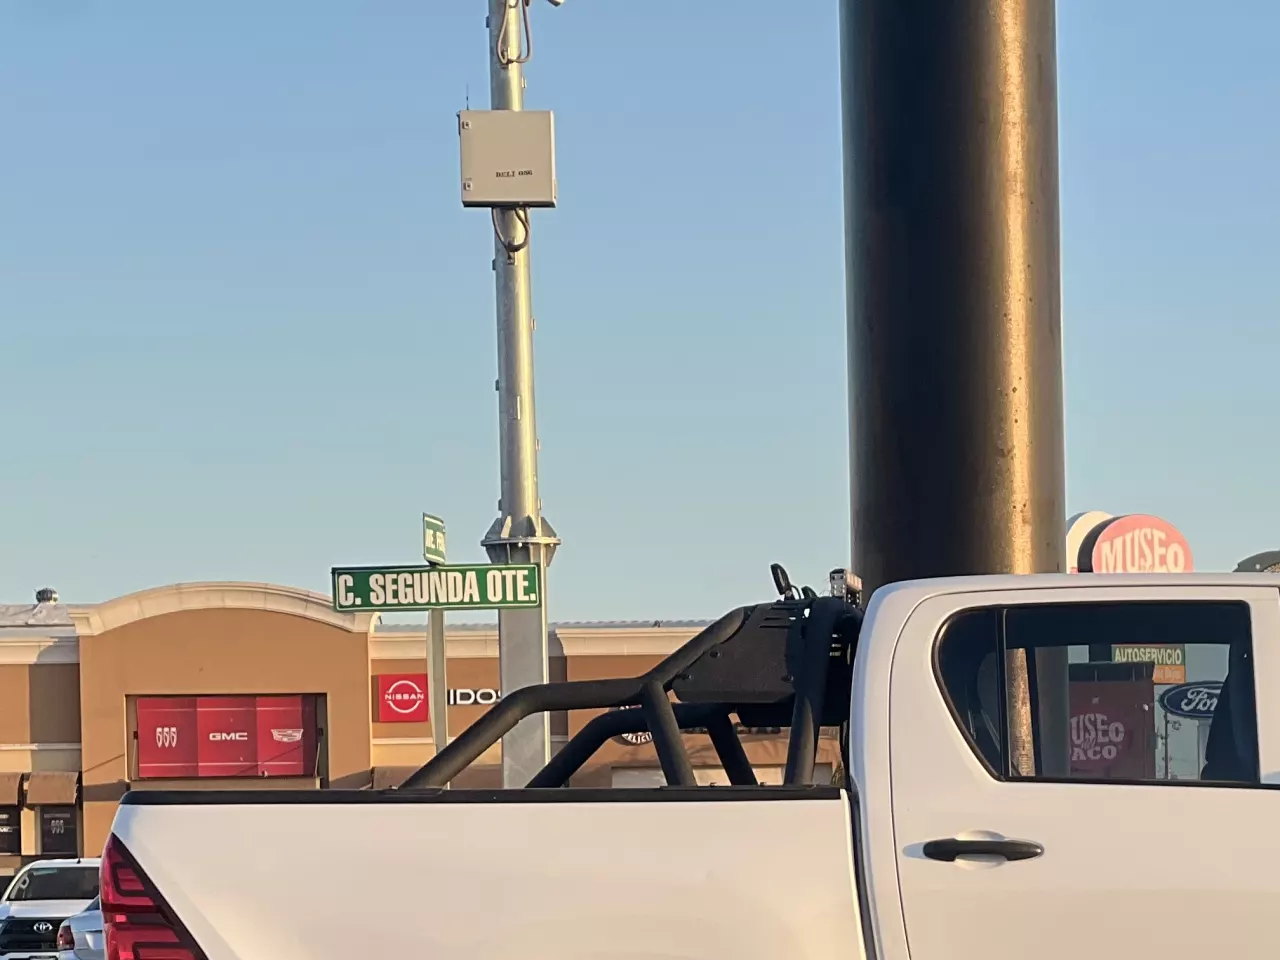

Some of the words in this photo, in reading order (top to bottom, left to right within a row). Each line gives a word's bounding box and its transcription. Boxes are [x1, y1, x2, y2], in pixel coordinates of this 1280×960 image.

[1101, 527, 1185, 573] MUSEO
[338, 574, 362, 606] C.
[369, 571, 480, 605] SEGUNDA
[486, 570, 537, 603] OTE.
[1114, 647, 1182, 665] AUTOSERVICIO
[384, 693, 424, 701] NISSAN
[449, 688, 500, 706] IDO
[1181, 688, 1221, 712] For
[209, 731, 248, 741] GMC
[1070, 713, 1125, 745] USEO
[1070, 745, 1118, 761] ACO
